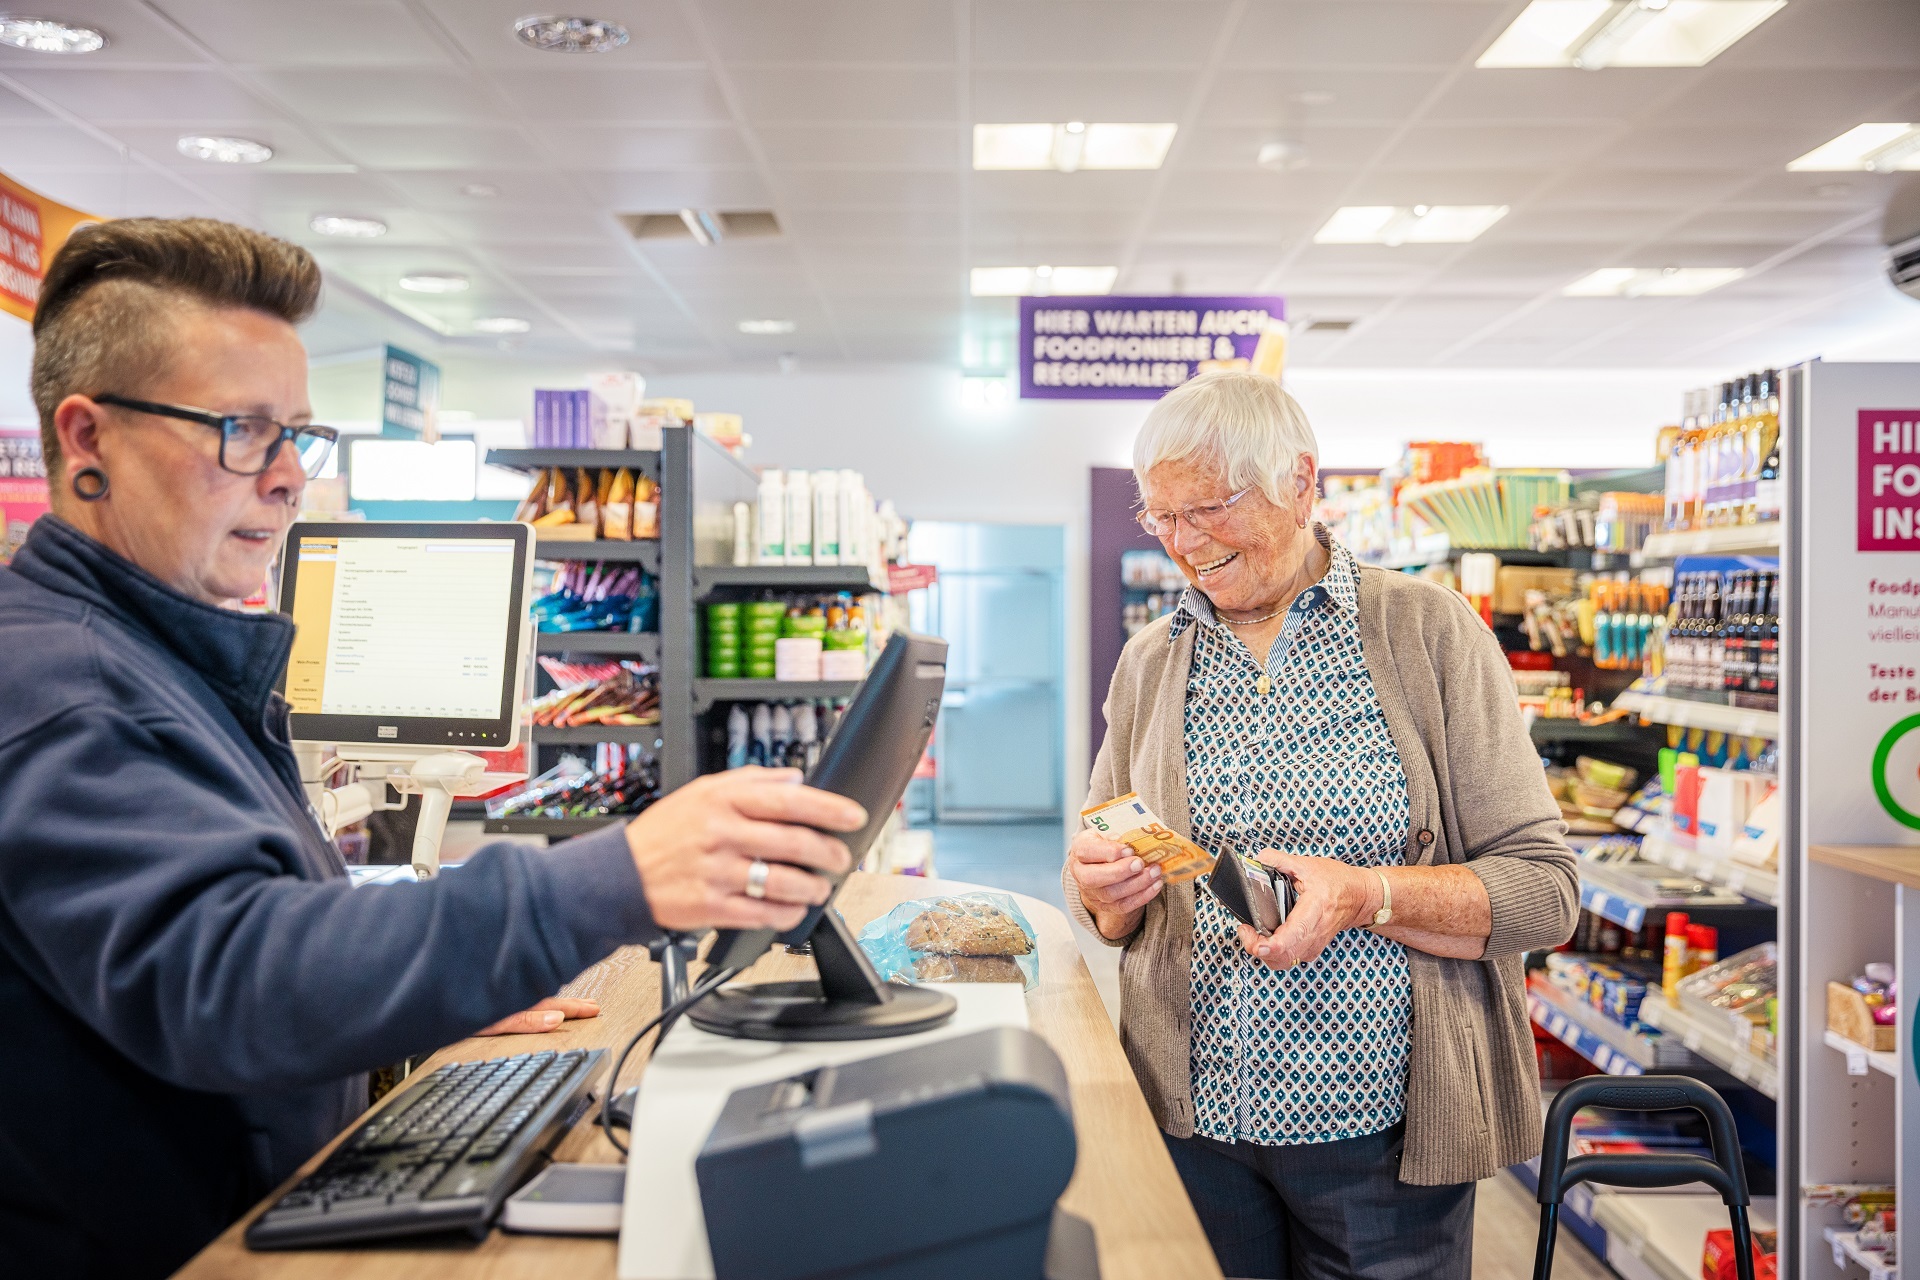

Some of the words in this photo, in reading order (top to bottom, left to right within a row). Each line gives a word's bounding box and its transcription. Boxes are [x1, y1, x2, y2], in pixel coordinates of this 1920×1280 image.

[1033, 309, 1090, 334] HIER
[1093, 309, 1198, 335] WARTEN
[1199, 309, 1269, 336] AUCH
[1033, 336, 1212, 361] FOODPIONIERE
[1213, 336, 1235, 360] &
[1873, 421, 1920, 454] HI
[1868, 663, 1915, 678] Teste
[1868, 687, 1899, 702] der
[1090, 816, 1110, 832] 50
[1140, 822, 1175, 841] 50
